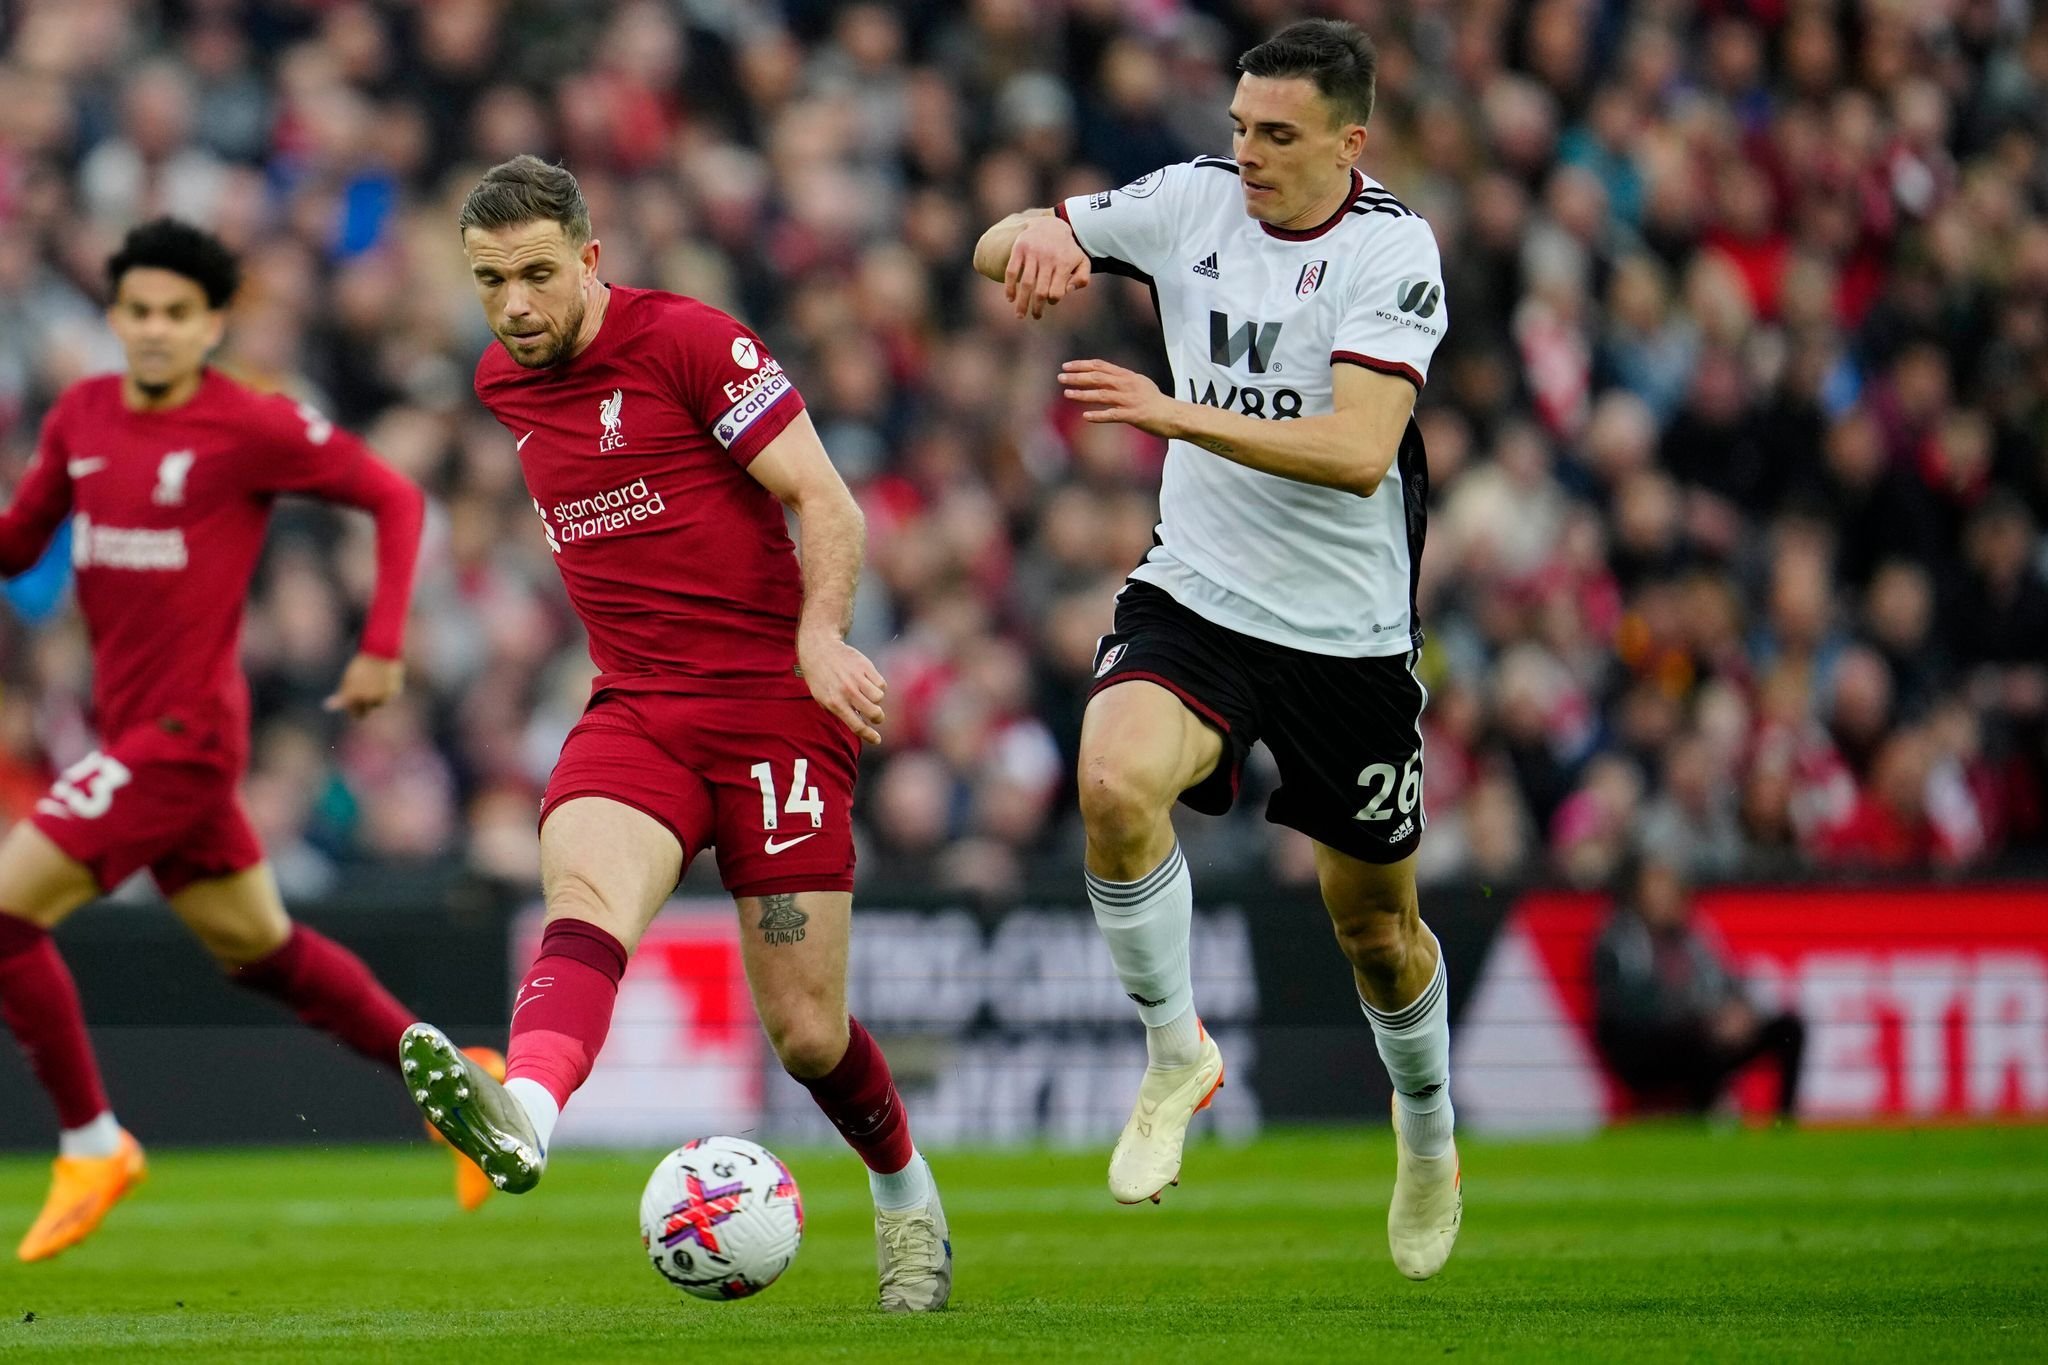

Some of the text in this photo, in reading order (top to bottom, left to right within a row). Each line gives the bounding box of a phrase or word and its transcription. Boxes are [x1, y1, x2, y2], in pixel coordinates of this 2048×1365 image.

[1193, 264, 1220, 280] adidas
[1375, 310, 1438, 336] WORLD MOB
[723, 357, 783, 403] Expedi
[1189, 378, 1302, 420] W88
[553, 477, 649, 523] standard
[561, 492, 666, 542] chartered
[751, 759, 824, 830] 14
[1352, 748, 1419, 821] 26
[764, 928, 806, 947] 01/06/19
[1740, 952, 2048, 1116] ETR
